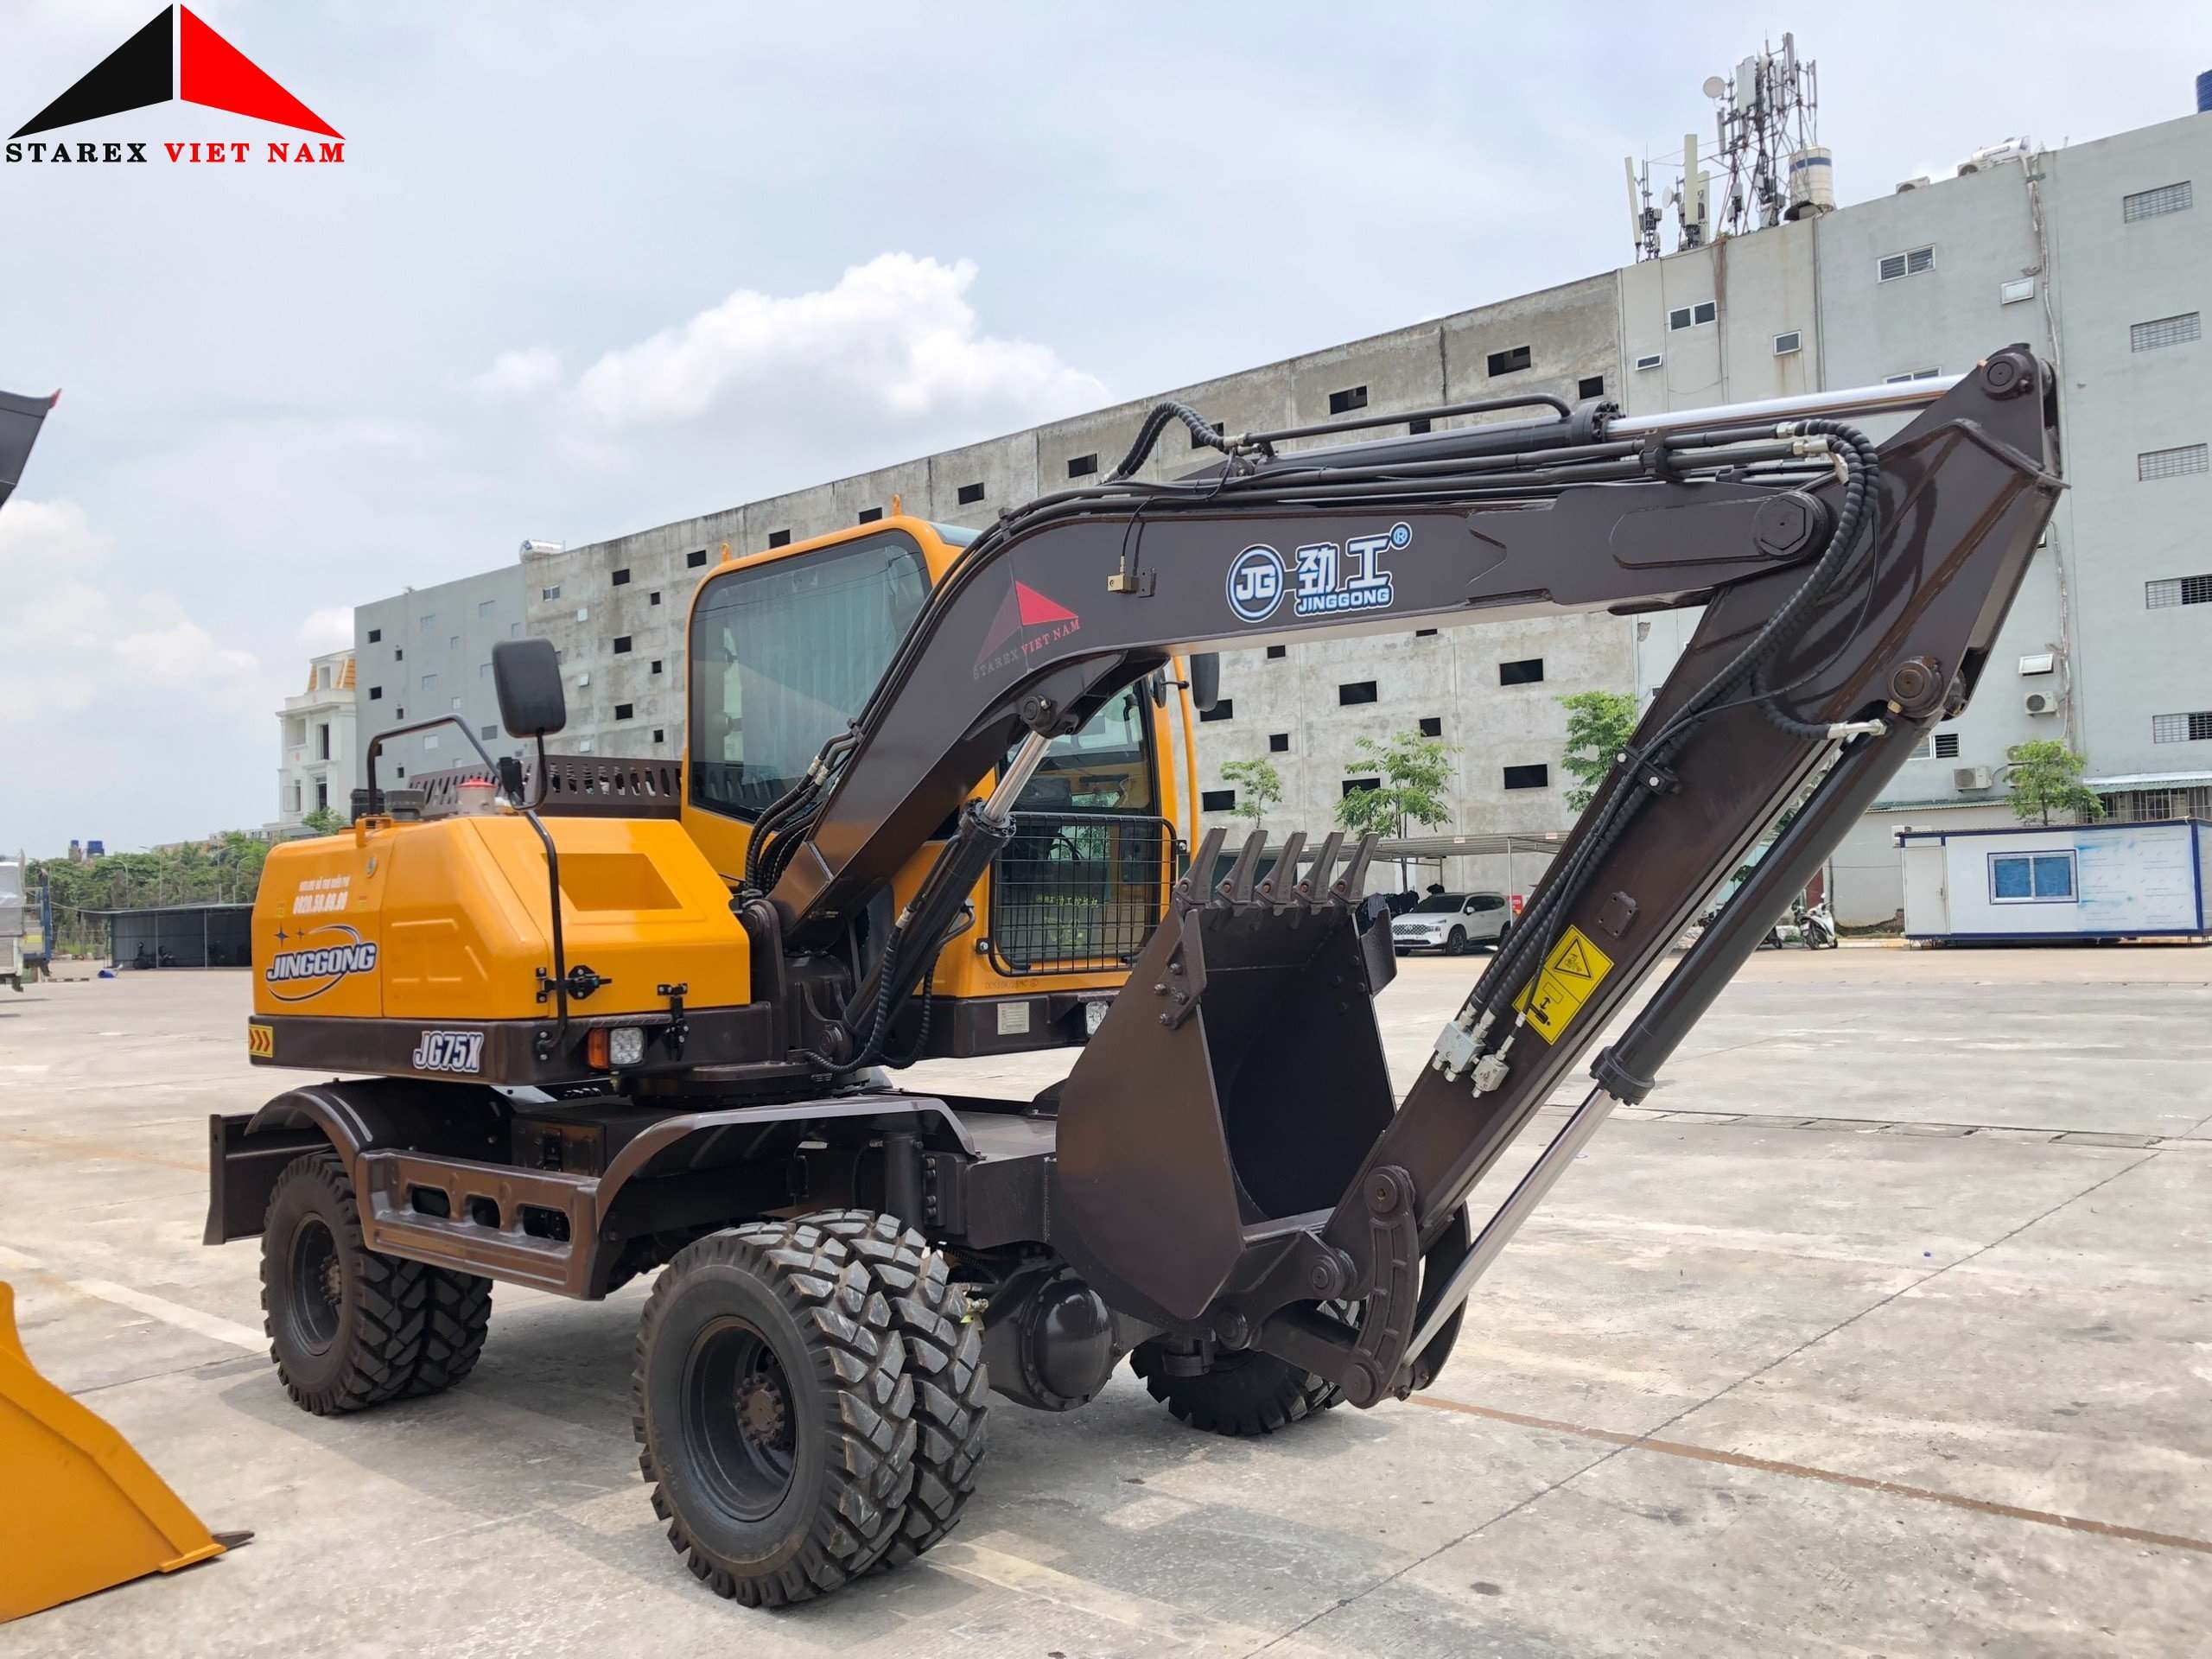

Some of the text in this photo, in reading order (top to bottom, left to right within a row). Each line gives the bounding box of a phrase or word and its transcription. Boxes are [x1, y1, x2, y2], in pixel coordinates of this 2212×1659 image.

[1236, 564, 1276, 601] JG
[1298, 588, 1390, 613] JINGGONG
[973, 619, 1081, 680] STAREX VIET NAM
[266, 944, 377, 982] JINGGONG
[414, 1032, 483, 1072] JG75X
